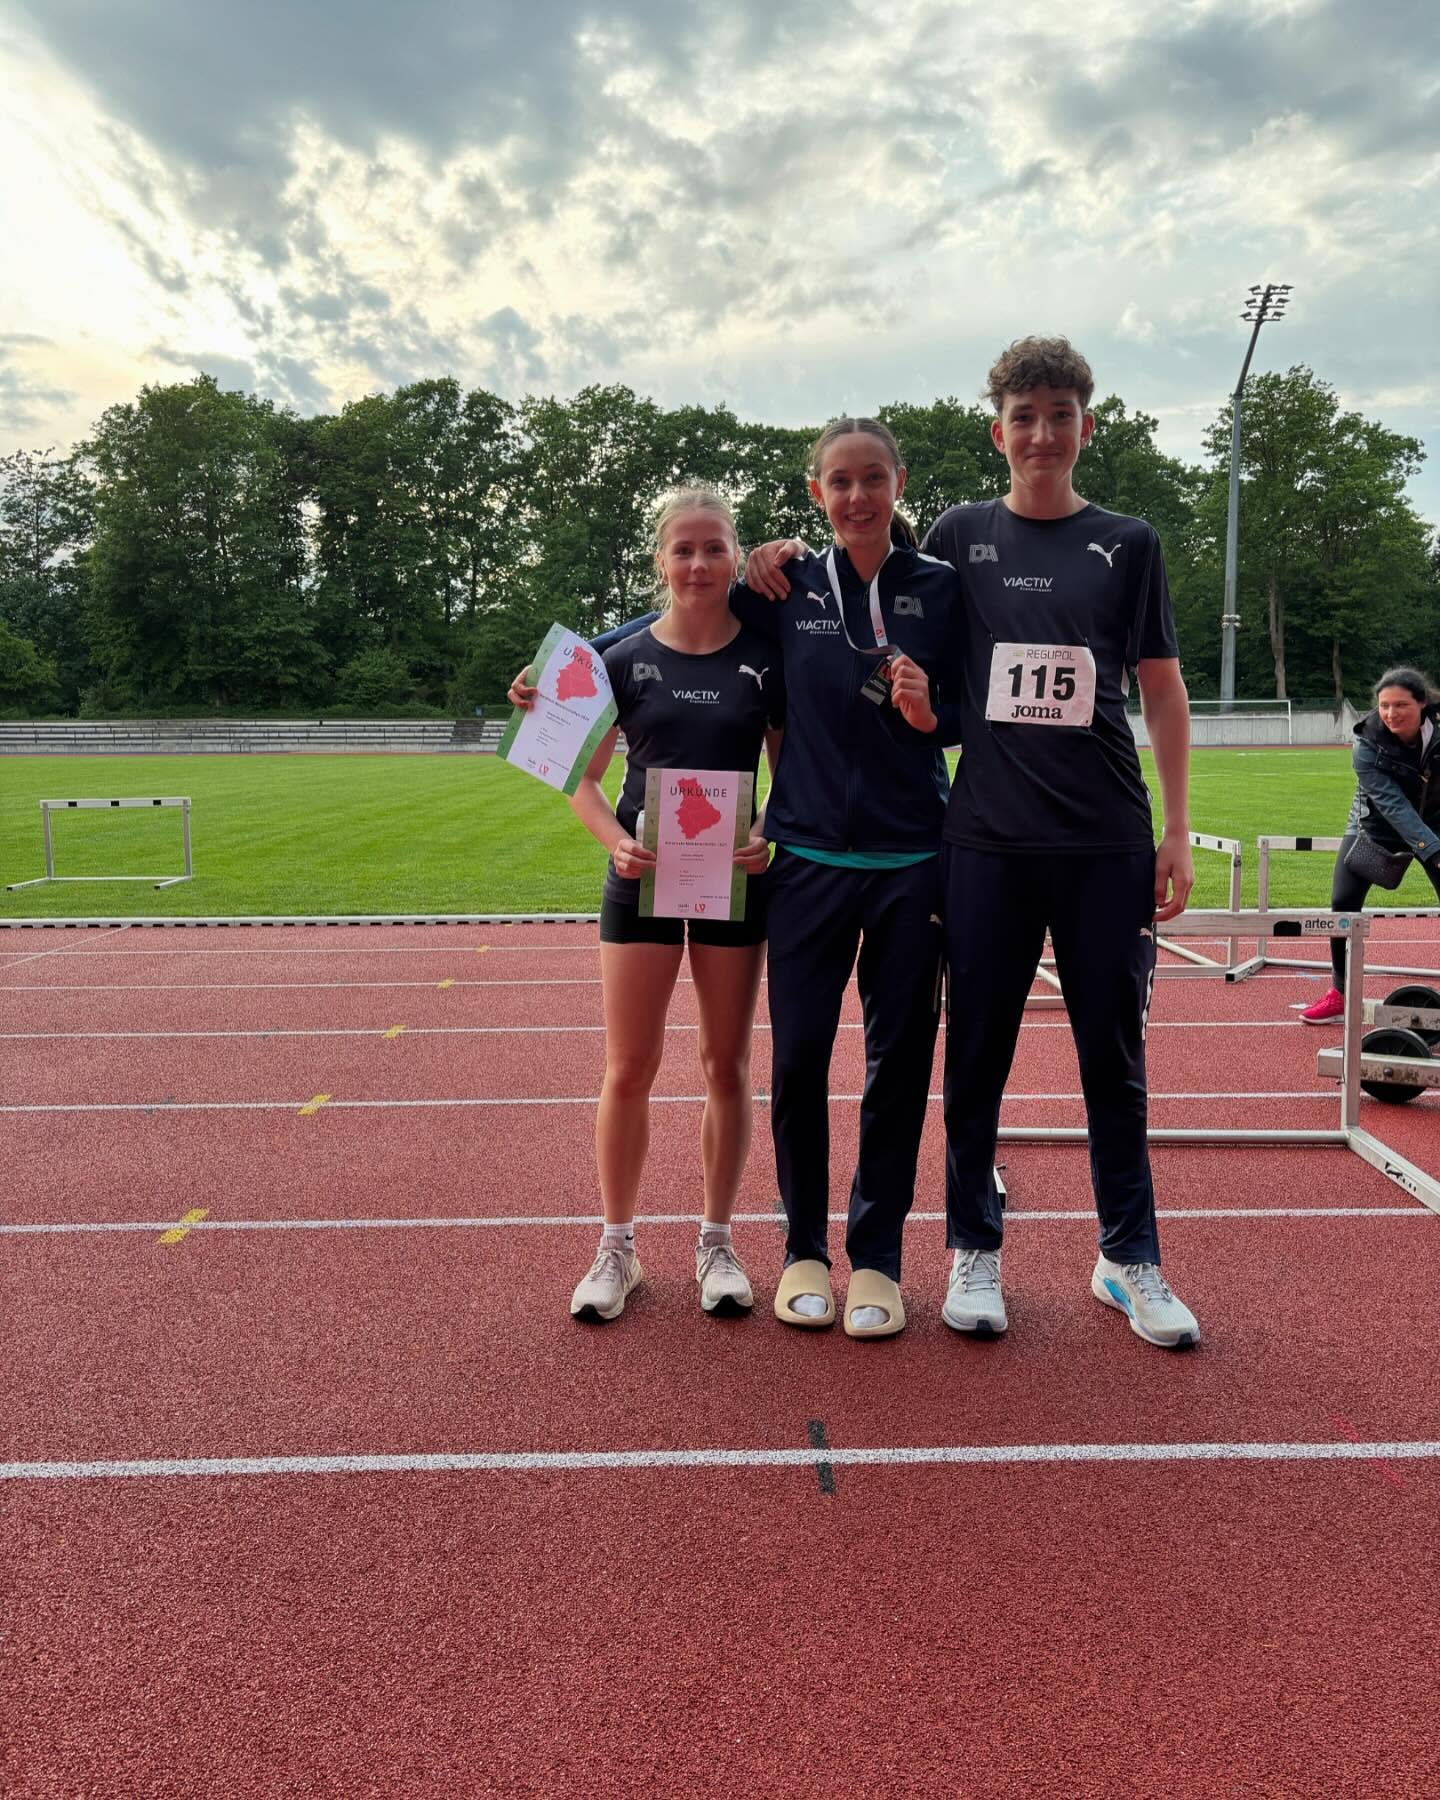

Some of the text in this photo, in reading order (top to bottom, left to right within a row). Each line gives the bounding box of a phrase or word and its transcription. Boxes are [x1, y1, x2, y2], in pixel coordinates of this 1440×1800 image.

[1003, 577, 1053, 588] VIACTIV
[795, 619, 841, 630] VIACTIV
[1026, 649, 1075, 661] REGUPOL
[1008, 664, 1076, 701] 115
[672, 689, 720, 700] VIACTIV
[669, 785, 728, 798] URKUNDE
[1305, 917, 1334, 929] artec
